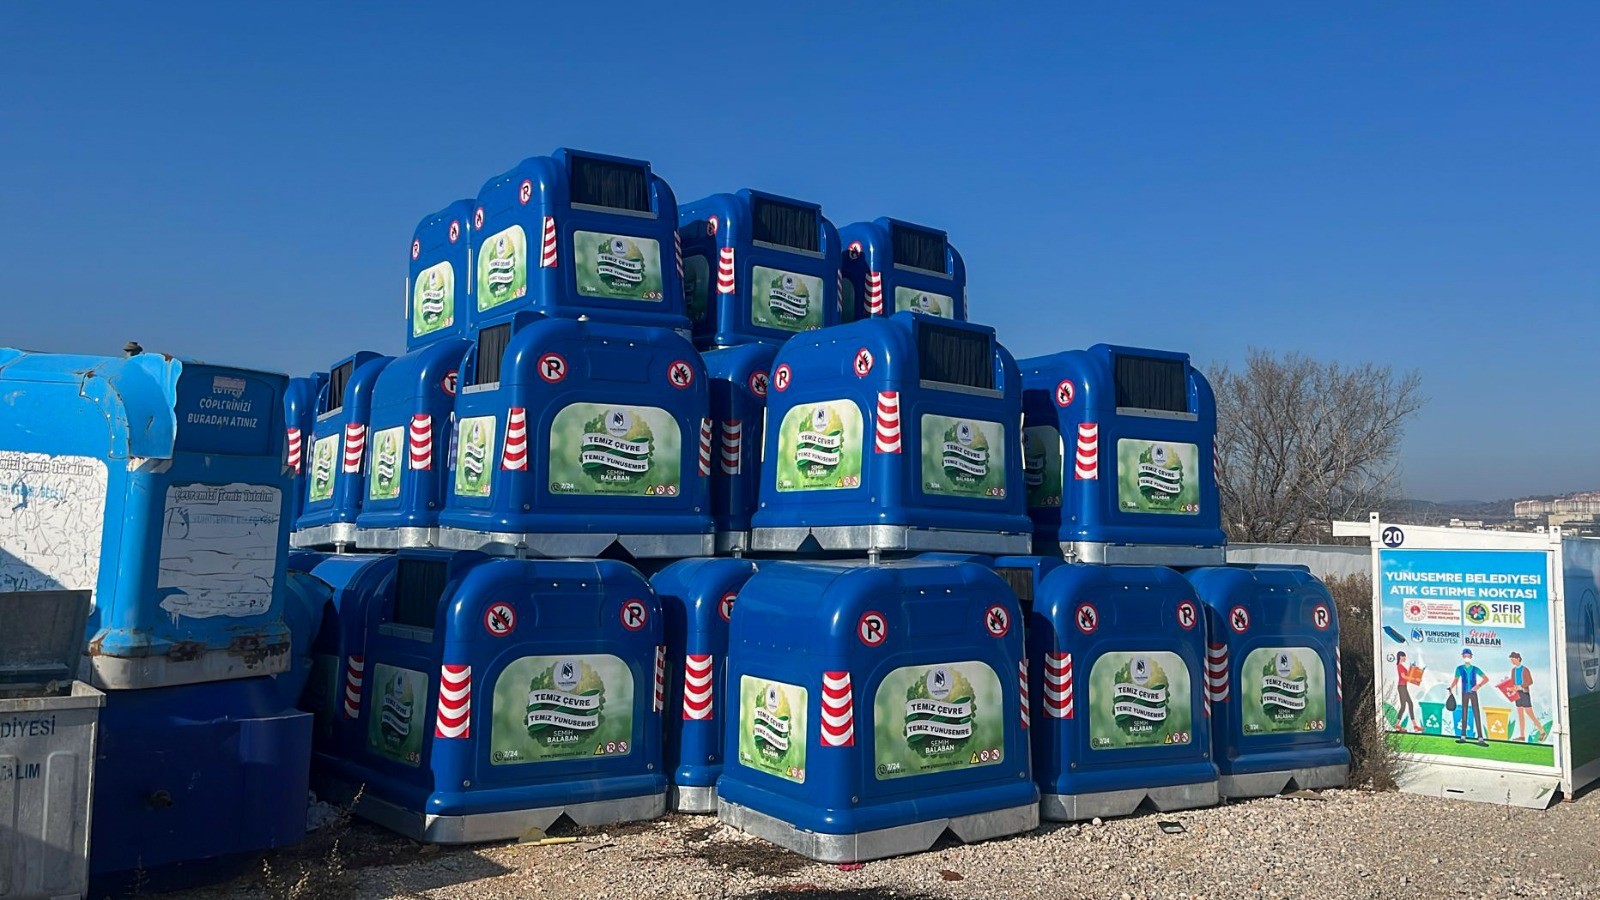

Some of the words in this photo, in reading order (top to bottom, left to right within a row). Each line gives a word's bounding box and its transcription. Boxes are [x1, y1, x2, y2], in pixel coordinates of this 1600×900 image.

[188, 413, 229, 425] BURADAN
[230, 416, 258, 428] ATINIZ
[588, 436, 612, 447] TEMİZ
[615, 442, 640, 452] ÇEVRE
[607, 457, 646, 470] YUNUSEMRE
[1383, 530, 1403, 544] 20
[1386, 572, 1462, 583] YUNUSEMRE
[1466, 574, 1541, 585] BELEDİYESİ
[1390, 585, 1417, 595] ATIK
[1421, 586, 1476, 597] GETİRME
[1478, 588, 1537, 599] NOKTASI
[1492, 604, 1521, 614] SIFIR
[1492, 614, 1522, 624] ATIK
[1470, 628, 1496, 638] Semih
[1465, 637, 1501, 646] BALABAN
[535, 694, 561, 703] TEMİZ
[563, 698, 590, 707] ÇEVRE
[1139, 691, 1159, 699] ÇEVRE
[937, 706, 963, 715] ÇEVRE
[0, 715, 56, 738] DİYESİ
[554, 716, 596, 727] YUNUSEMRE
[930, 726, 970, 735] YUNUSEMRE
[925, 745, 955, 754] BALABAN
